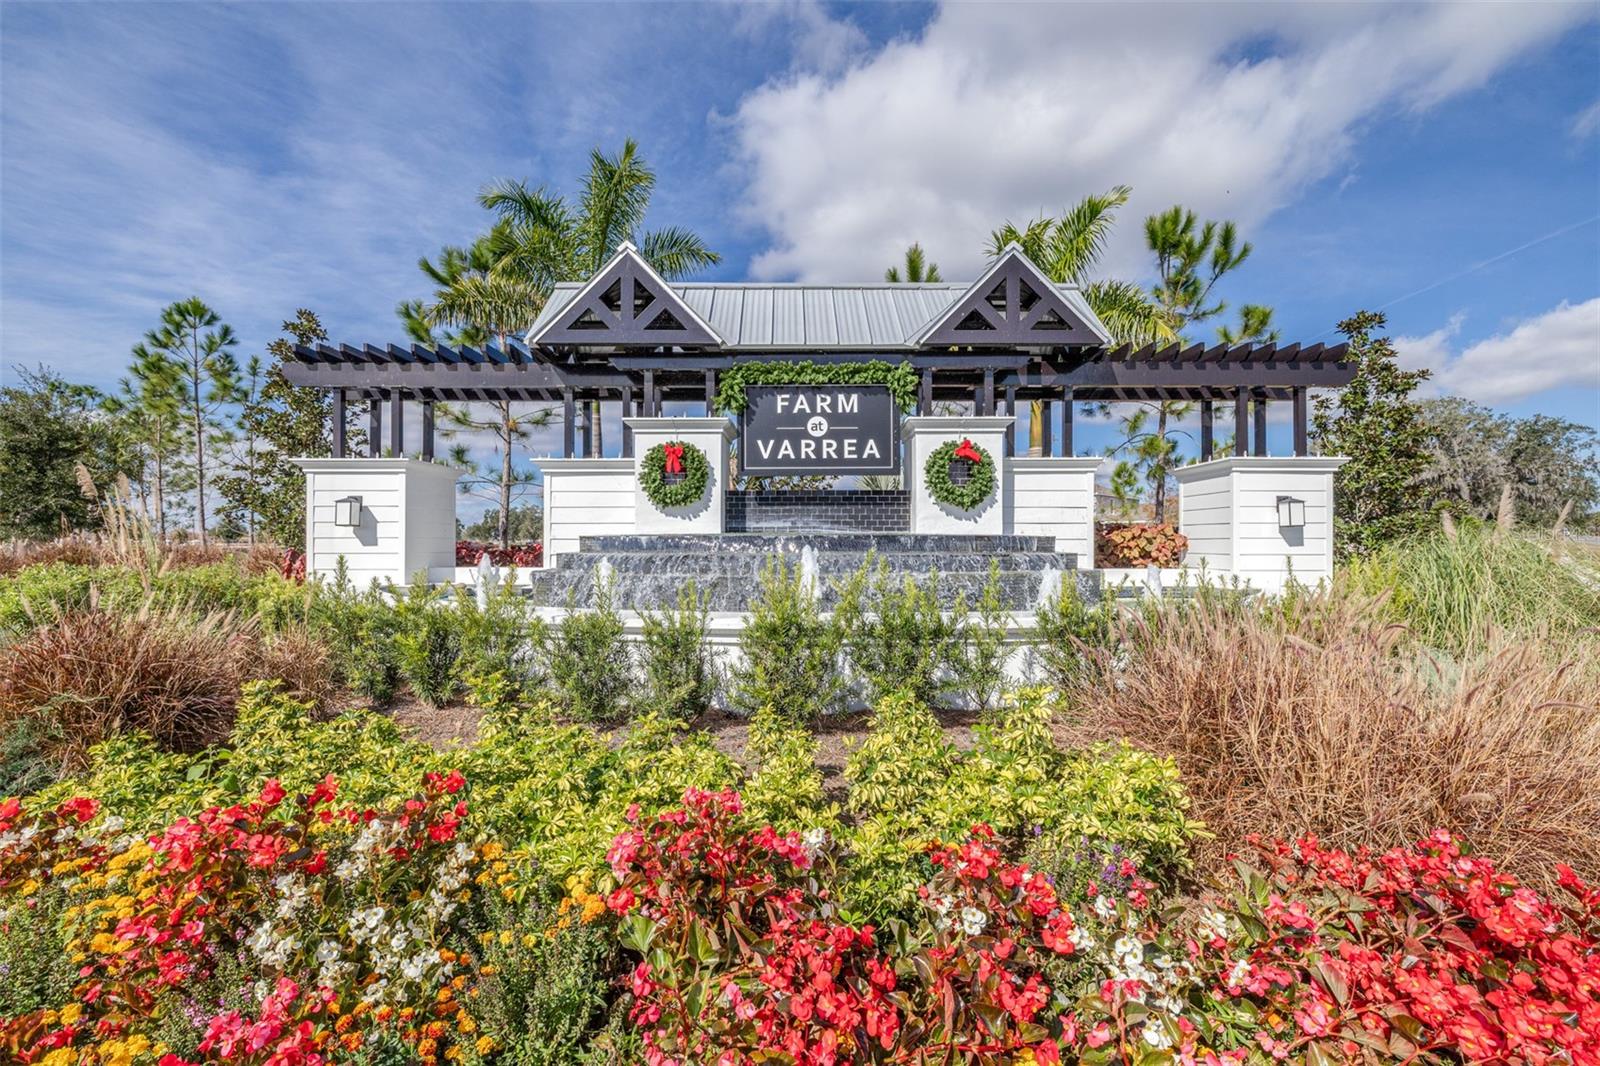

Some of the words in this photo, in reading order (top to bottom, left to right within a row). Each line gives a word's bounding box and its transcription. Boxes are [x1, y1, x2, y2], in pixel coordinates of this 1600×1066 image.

[776, 393, 859, 414] FARM
[810, 421, 824, 432] at
[756, 439, 881, 459] VARREA
